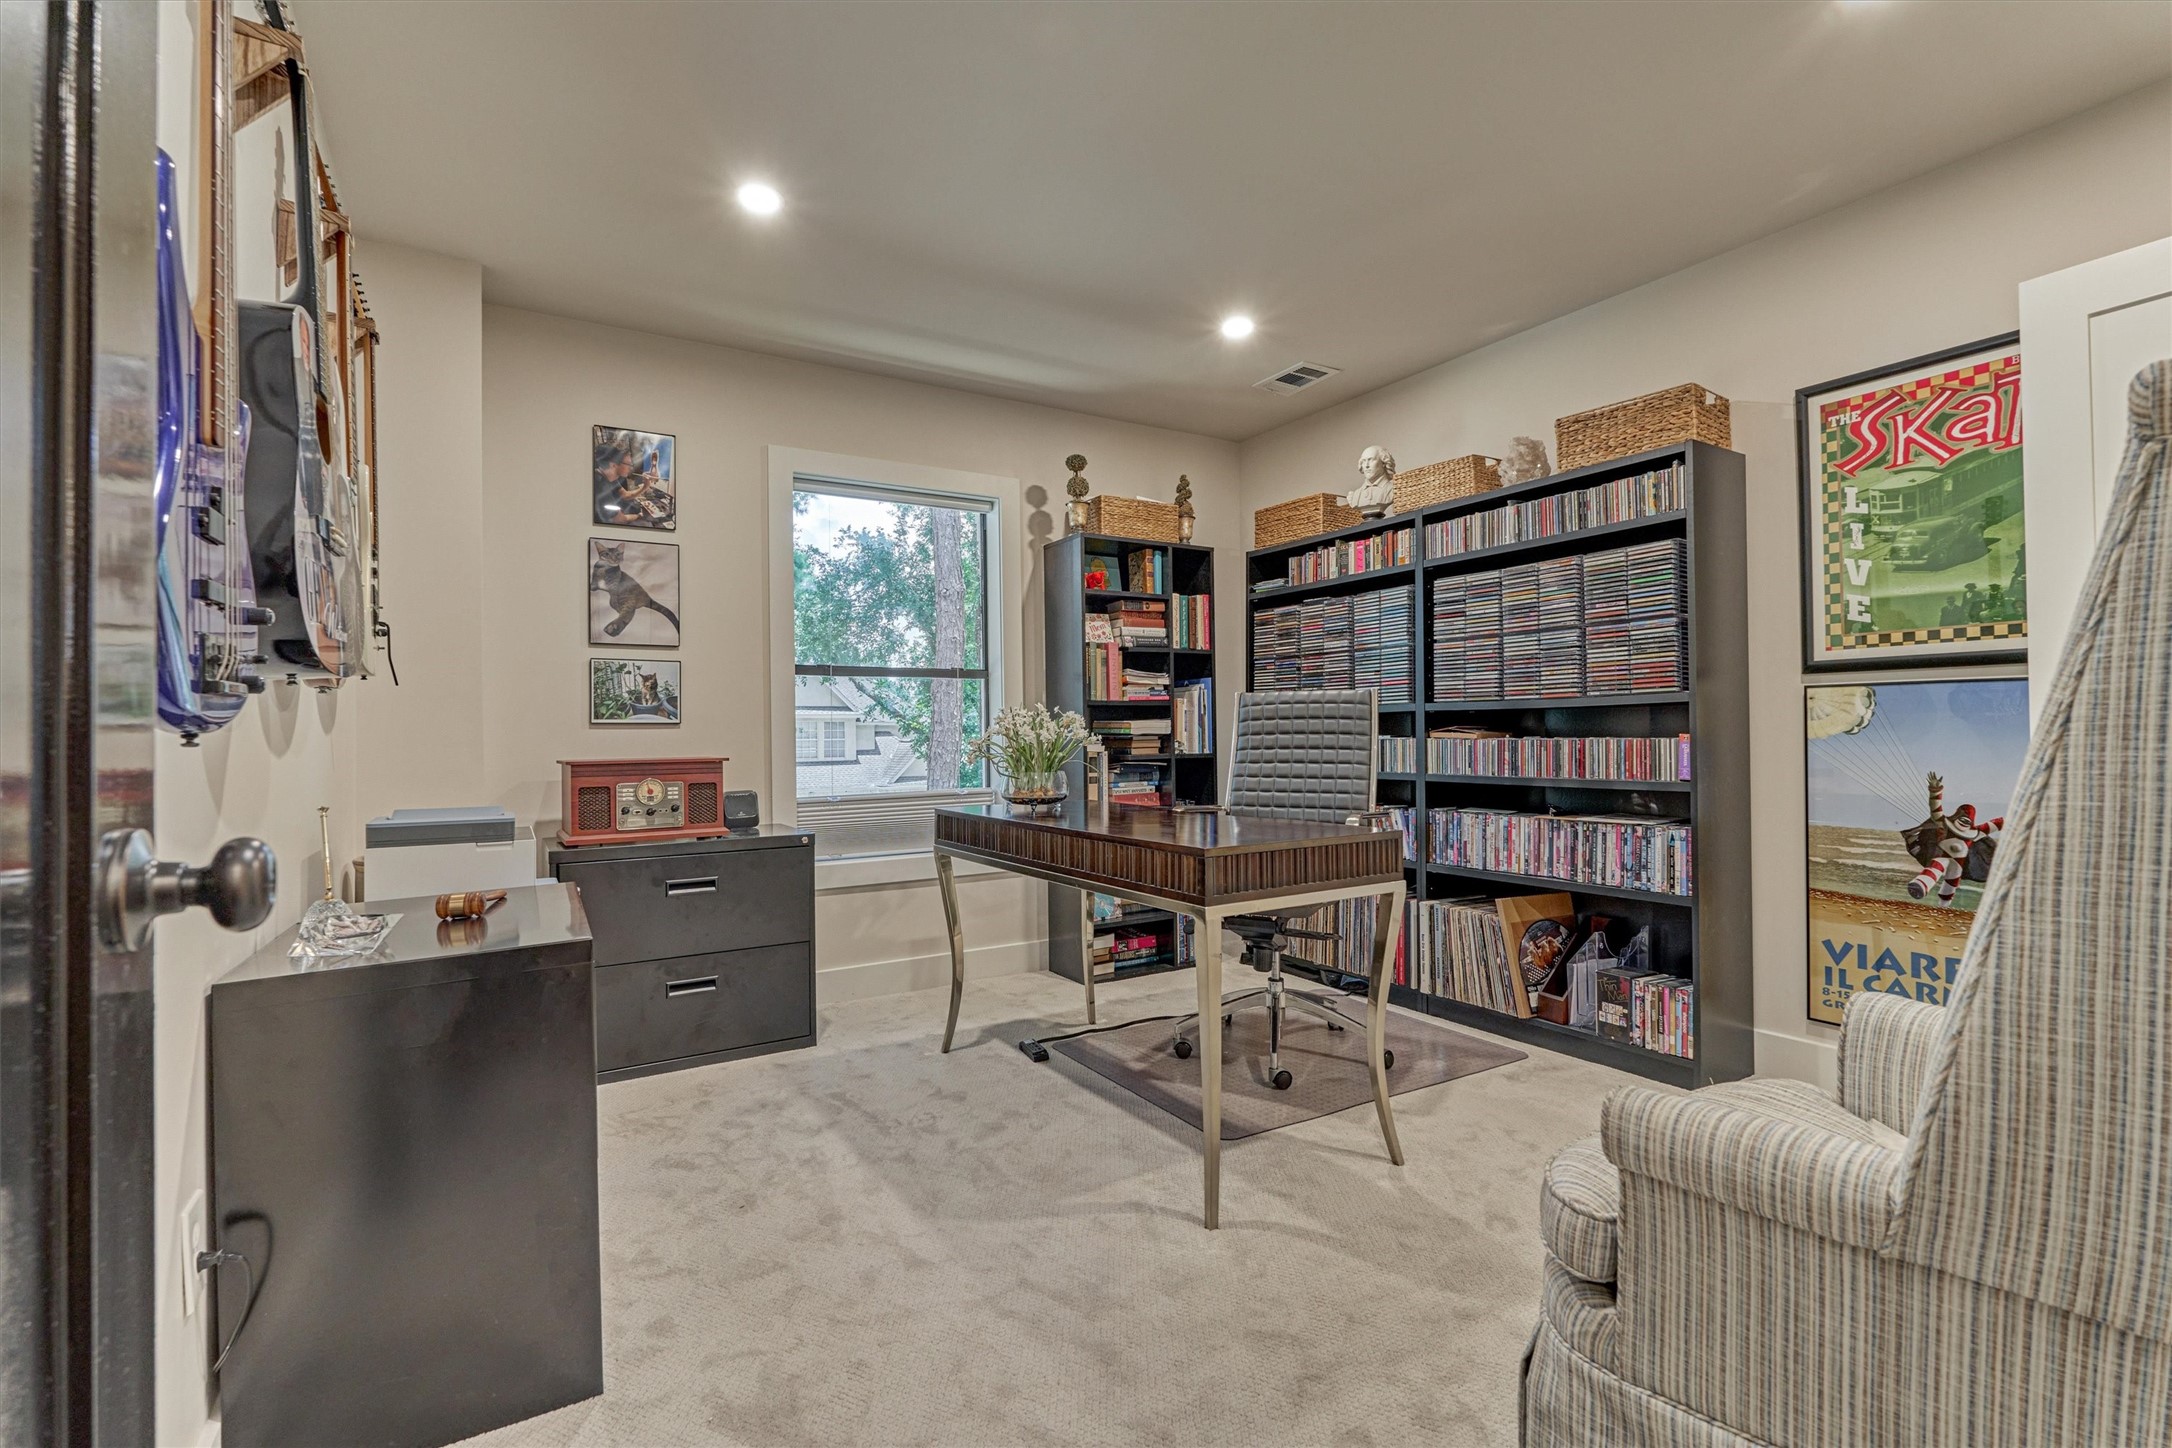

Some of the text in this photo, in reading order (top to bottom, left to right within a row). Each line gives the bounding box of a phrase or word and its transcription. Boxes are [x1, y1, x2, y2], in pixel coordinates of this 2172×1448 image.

[1828, 409, 1862, 428] THE
[1844, 486, 1872, 623] LIVE
[1825, 966, 1854, 990] IL
